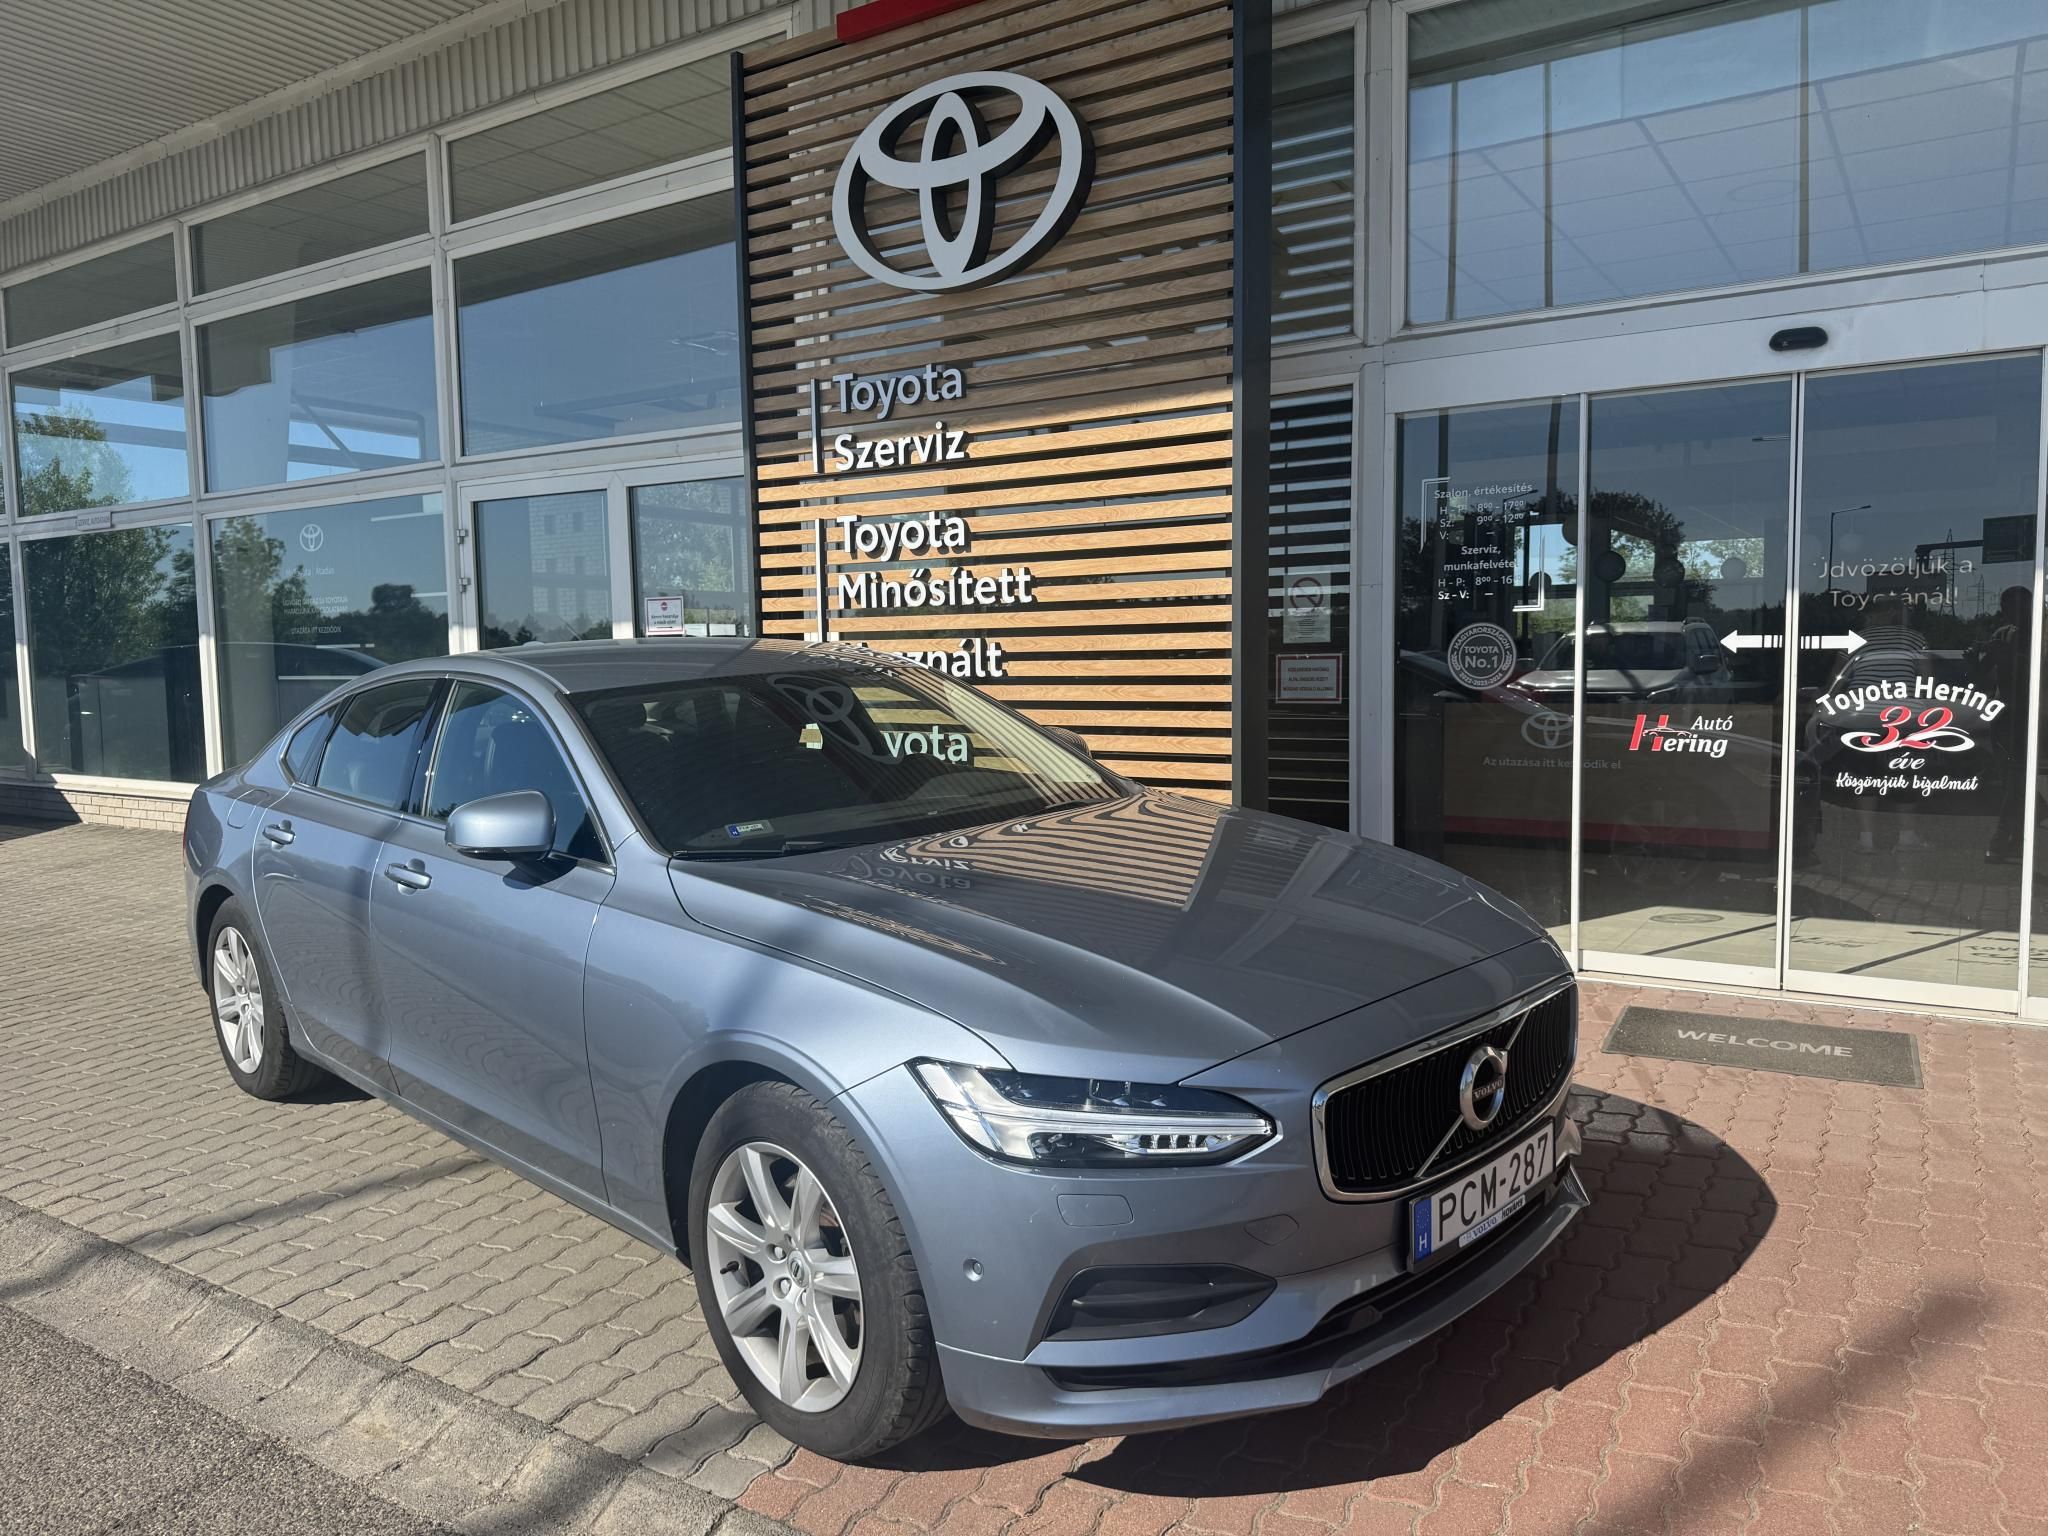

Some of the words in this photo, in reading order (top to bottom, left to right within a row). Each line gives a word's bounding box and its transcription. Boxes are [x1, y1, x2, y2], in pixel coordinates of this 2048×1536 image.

[832, 363, 962, 419] Toyota
[834, 421, 965, 471] Szerviz
[1434, 488, 1471, 499] Szalon,
[1474, 483, 1533, 495] értékesítés
[837, 511, 965, 562] Toyota
[1461, 545, 1501, 555] Szerviz,
[1959, 559, 1973, 573] a
[838, 566, 1033, 609] Minősített
[1464, 646, 1499, 654] TOYOTA
[1465, 655, 1499, 668] No.1
[1815, 679, 1908, 716] Toyota
[1914, 676, 2006, 722] Hering
[1690, 715, 1733, 731] Autó
[1857, 705, 1957, 751] 32
[1629, 714, 1729, 758] Hering
[1888, 752, 1926, 770] éve
[1835, 772, 1910, 796] Köszönjük
[1912, 774, 1979, 797] bizalmát
[1676, 1029, 1854, 1058] WELCOME
[1474, 1079, 1503, 1099] VOLVO
[1438, 1131, 1549, 1242] PCM-287
[1473, 1217, 1498, 1237] VOLVO
[1419, 1232, 1428, 1252] H
